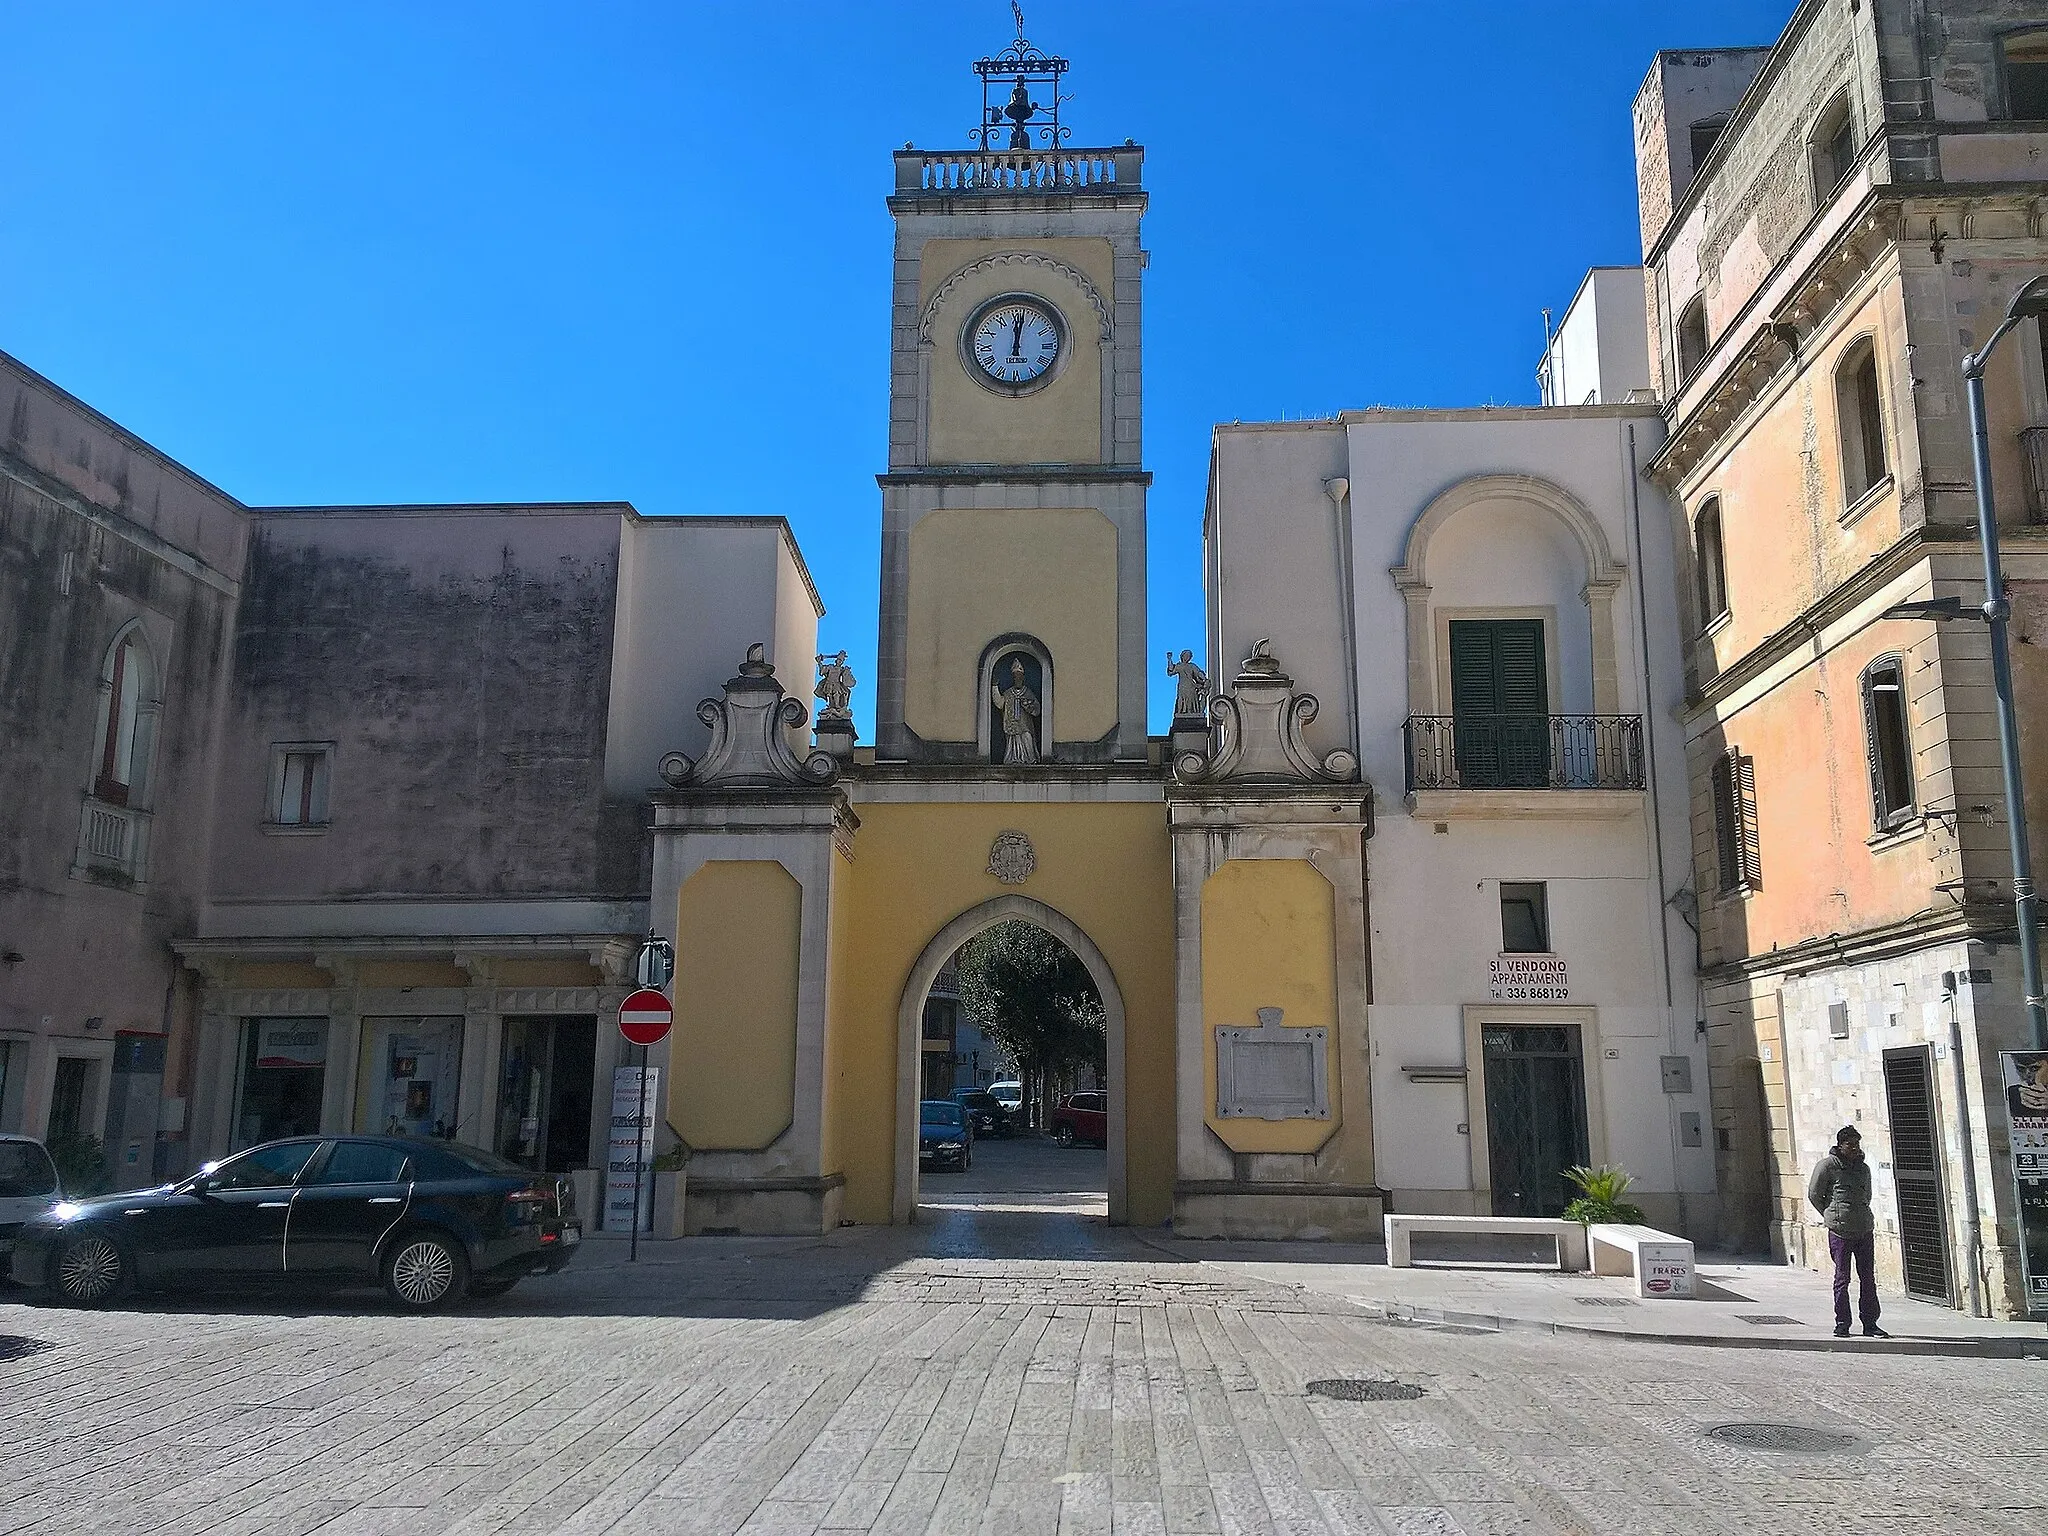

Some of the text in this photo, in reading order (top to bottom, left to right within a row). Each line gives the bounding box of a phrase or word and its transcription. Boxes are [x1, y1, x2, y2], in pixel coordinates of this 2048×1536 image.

[983, 328, 997, 338] X
[1490, 961, 1567, 972] SI VENDONO
[1491, 973, 1568, 984] APPARTAMENTI
[1507, 988, 1527, 999] 336
[1530, 988, 1569, 999] 868129
